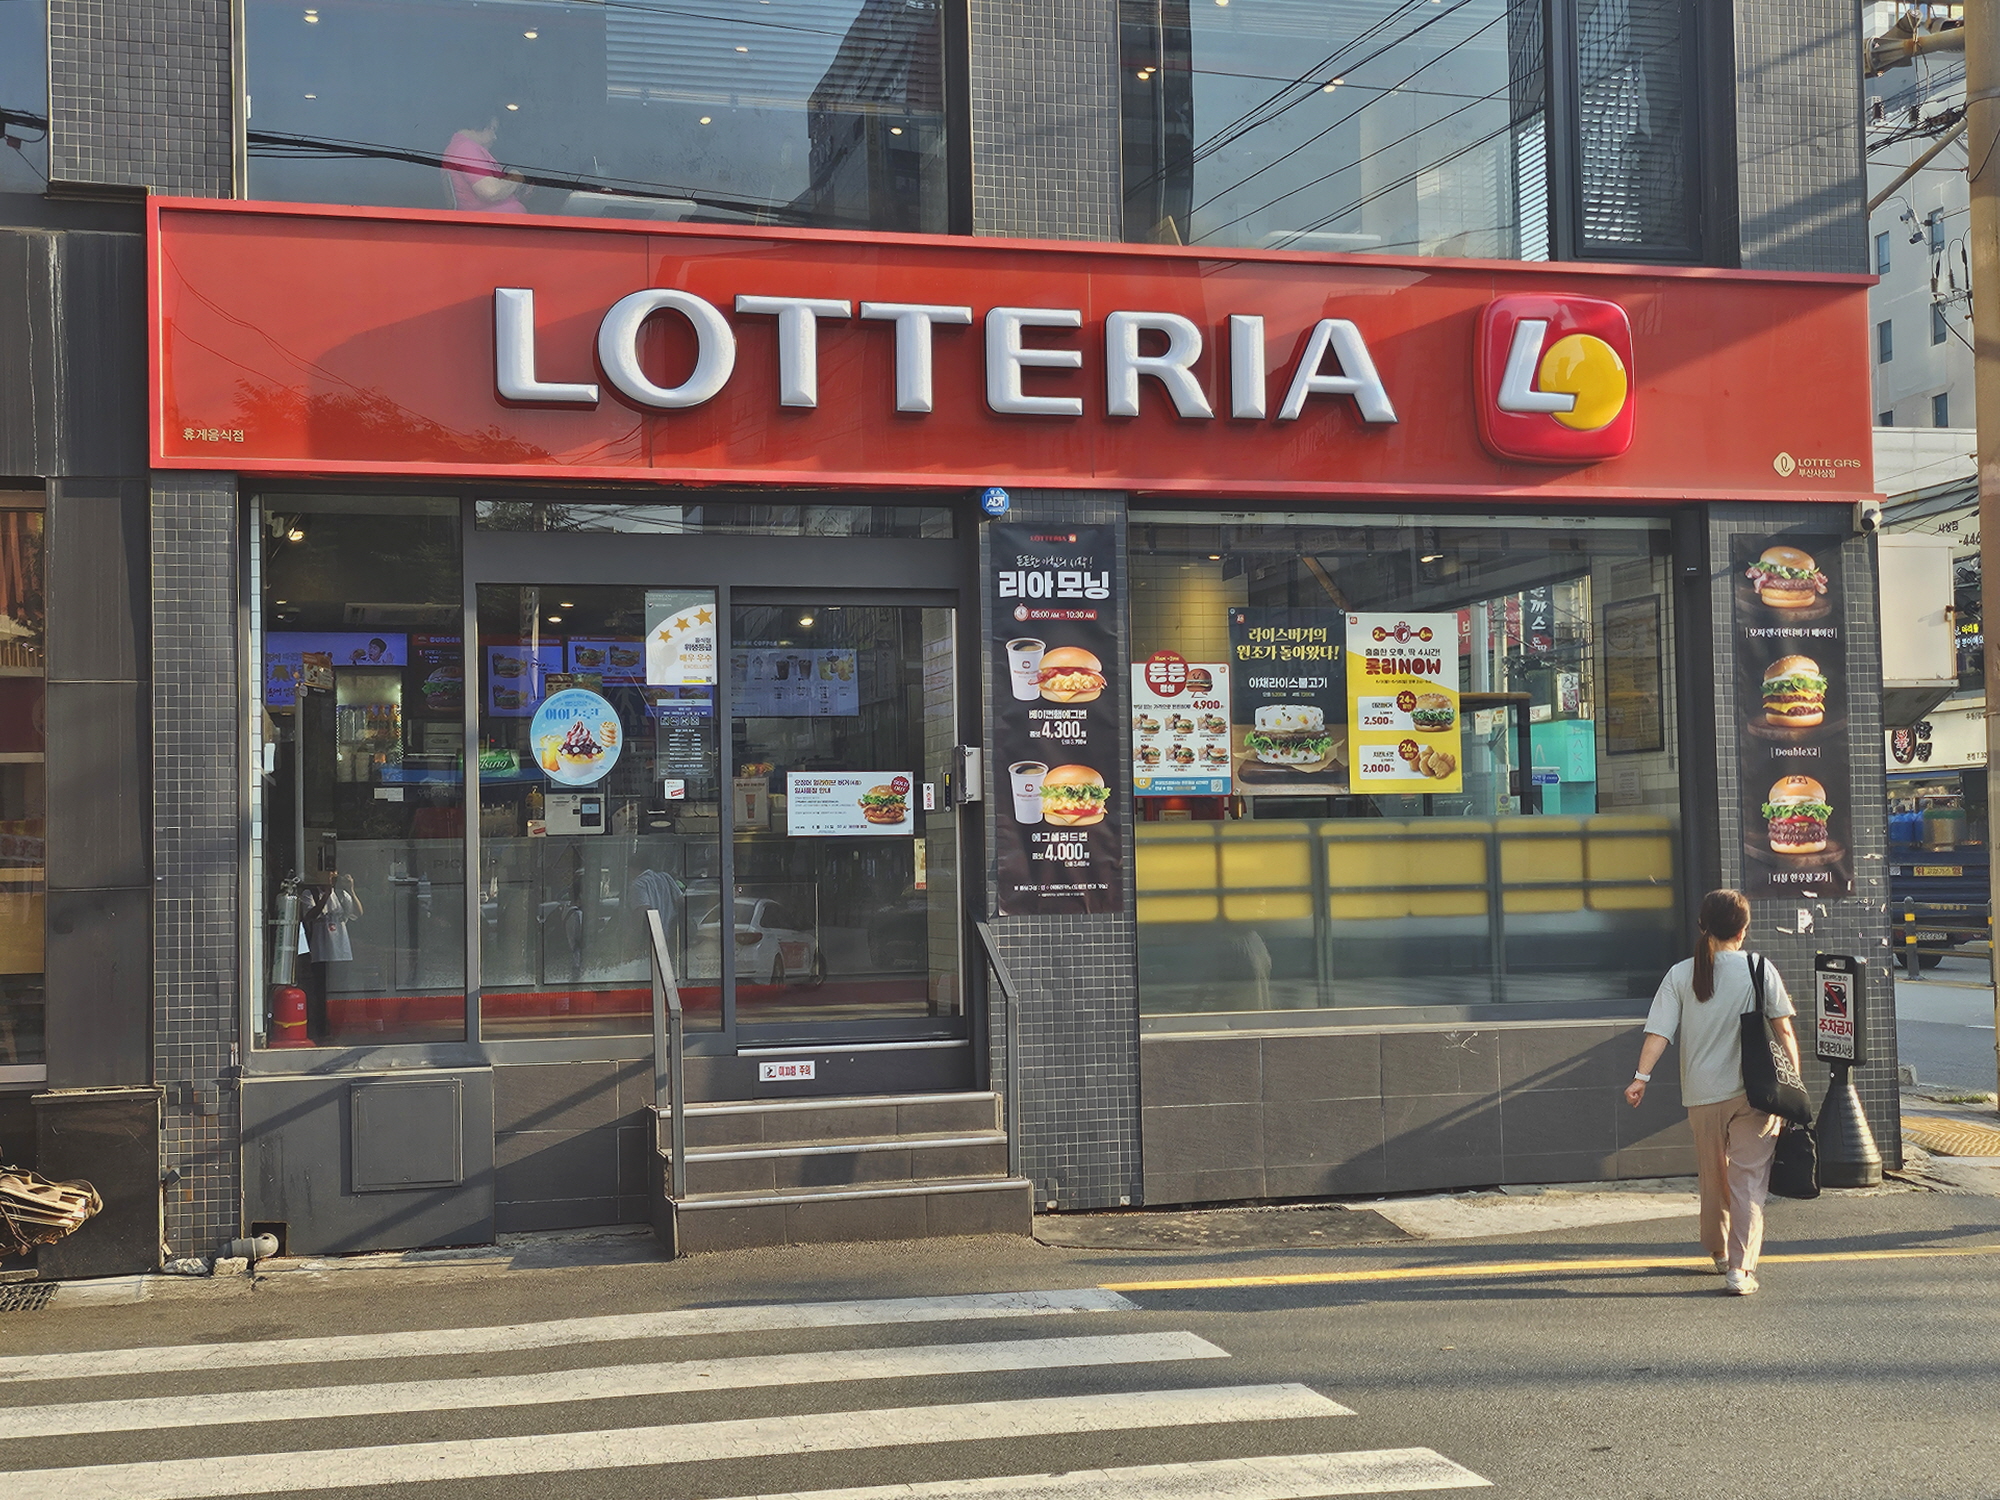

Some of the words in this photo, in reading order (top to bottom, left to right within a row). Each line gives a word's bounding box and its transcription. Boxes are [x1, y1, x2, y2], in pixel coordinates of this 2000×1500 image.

[493, 287, 1398, 423] LOTTERIA
[183, 428, 244, 442] 휴게음식점
[1798, 459, 1831, 467] LOTTE
[1834, 459, 1861, 468] GRS
[1799, 469, 1836, 478] 부산사상점
[986, 496, 1005, 507] ADT
[999, 571, 1053, 598] 리아
[1057, 571, 1110, 600] 모닝
[1248, 627, 1327, 643] 라이스버거의
[697, 654, 712, 662] 우수
[1236, 645, 1277, 661] 원조가
[1280, 645, 1340, 661] 돌아왔다!
[1248, 677, 1328, 689] 야채라이스불고기
[1775, 747, 1818, 757] DoubleX2
[1031, 832, 1088, 842] 에그샐러드번
[1819, 1018, 1853, 1036] 주차금지
